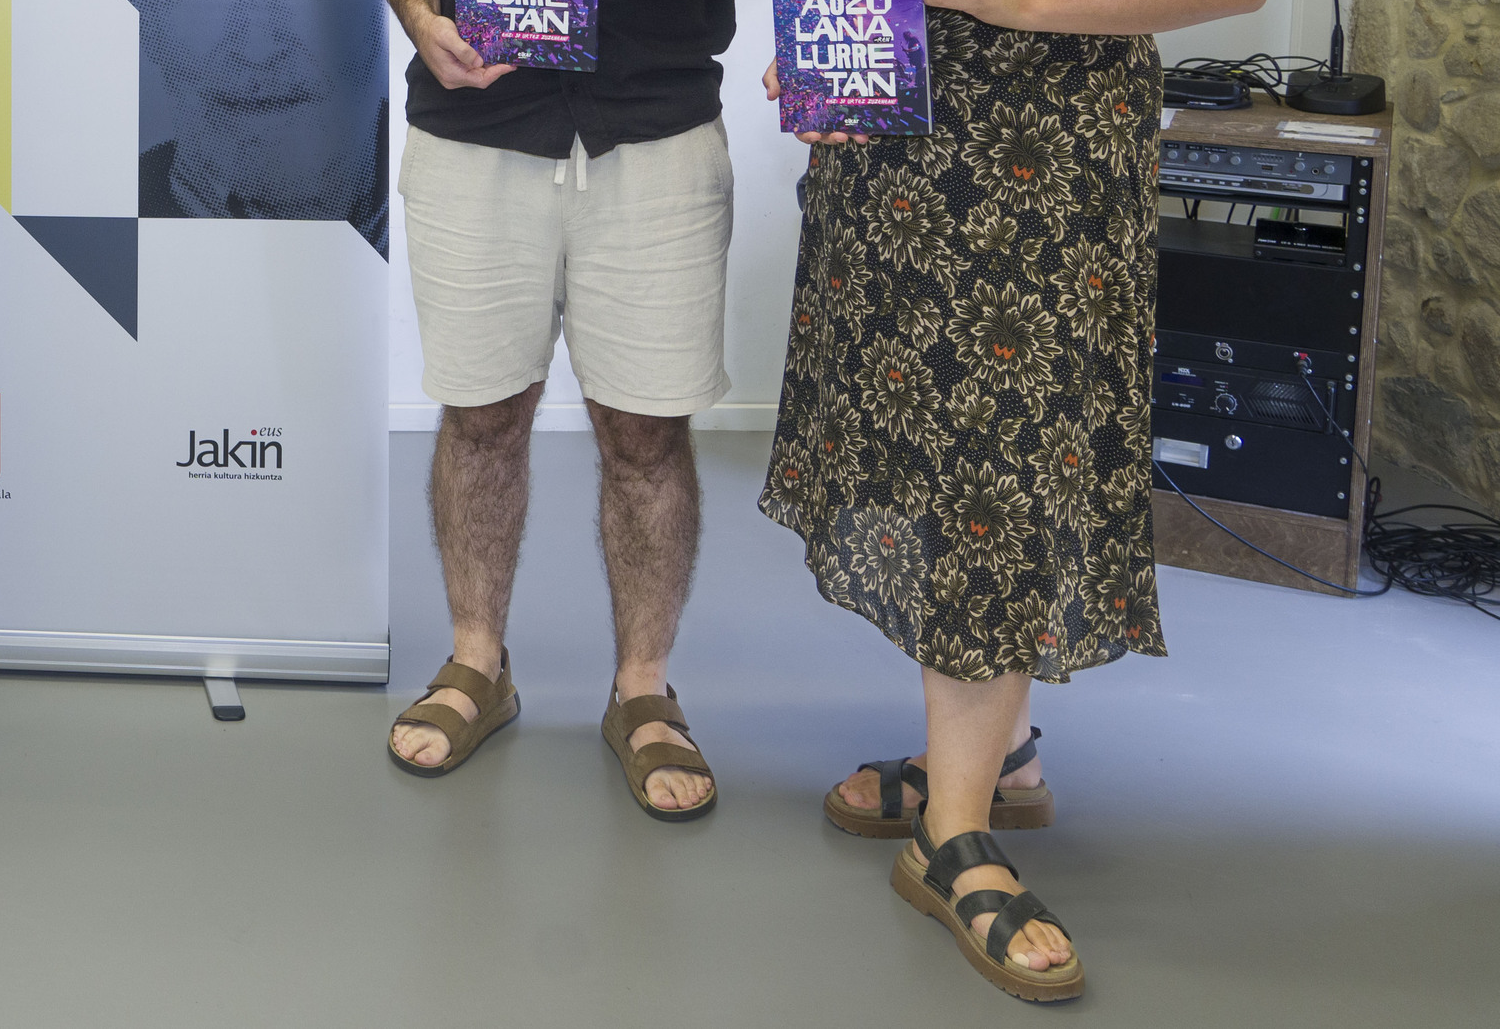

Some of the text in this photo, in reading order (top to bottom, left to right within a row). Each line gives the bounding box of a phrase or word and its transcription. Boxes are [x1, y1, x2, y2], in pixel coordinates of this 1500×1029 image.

[502, 7, 569, 34] TAN
[794, 15, 894, 41] LANA
[796, 43, 894, 69] LURRE
[824, 72, 896, 97] TAN
[176, 429, 283, 469] Jakin
[188, 471, 283, 481] herria kultura hizkuntza
